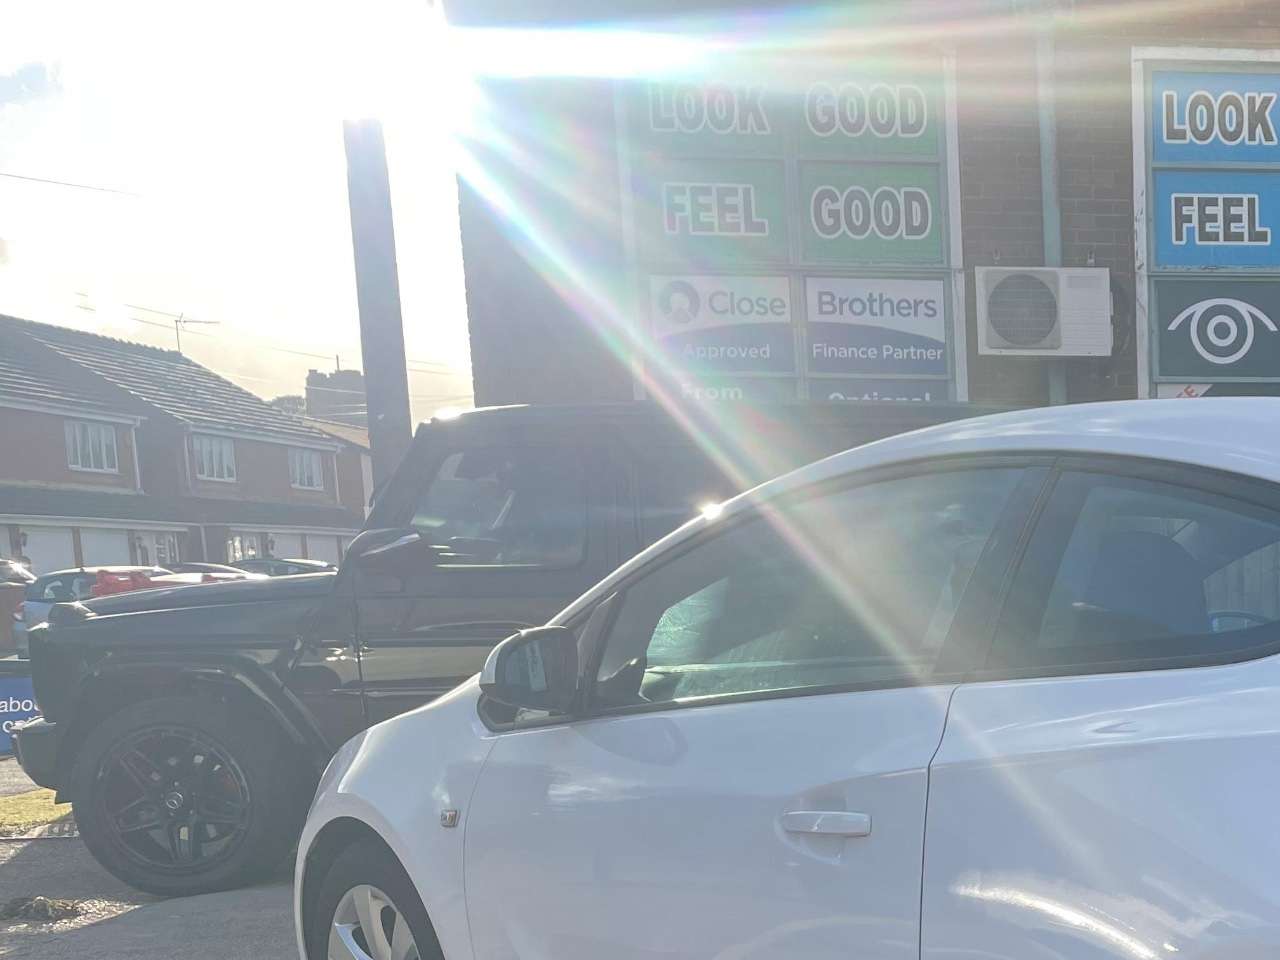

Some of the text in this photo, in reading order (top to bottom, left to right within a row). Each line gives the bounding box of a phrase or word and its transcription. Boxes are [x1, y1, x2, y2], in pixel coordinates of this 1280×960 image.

[650, 82, 927, 137] LOOK GOOD
[1162, 90, 1278, 145] LOOK
[663, 183, 932, 239] FEEL GOOD
[1171, 193, 1271, 245] FEEL
[708, 290, 937, 318] Close Brothers
[684, 343, 943, 362] Approved Finance Partner
